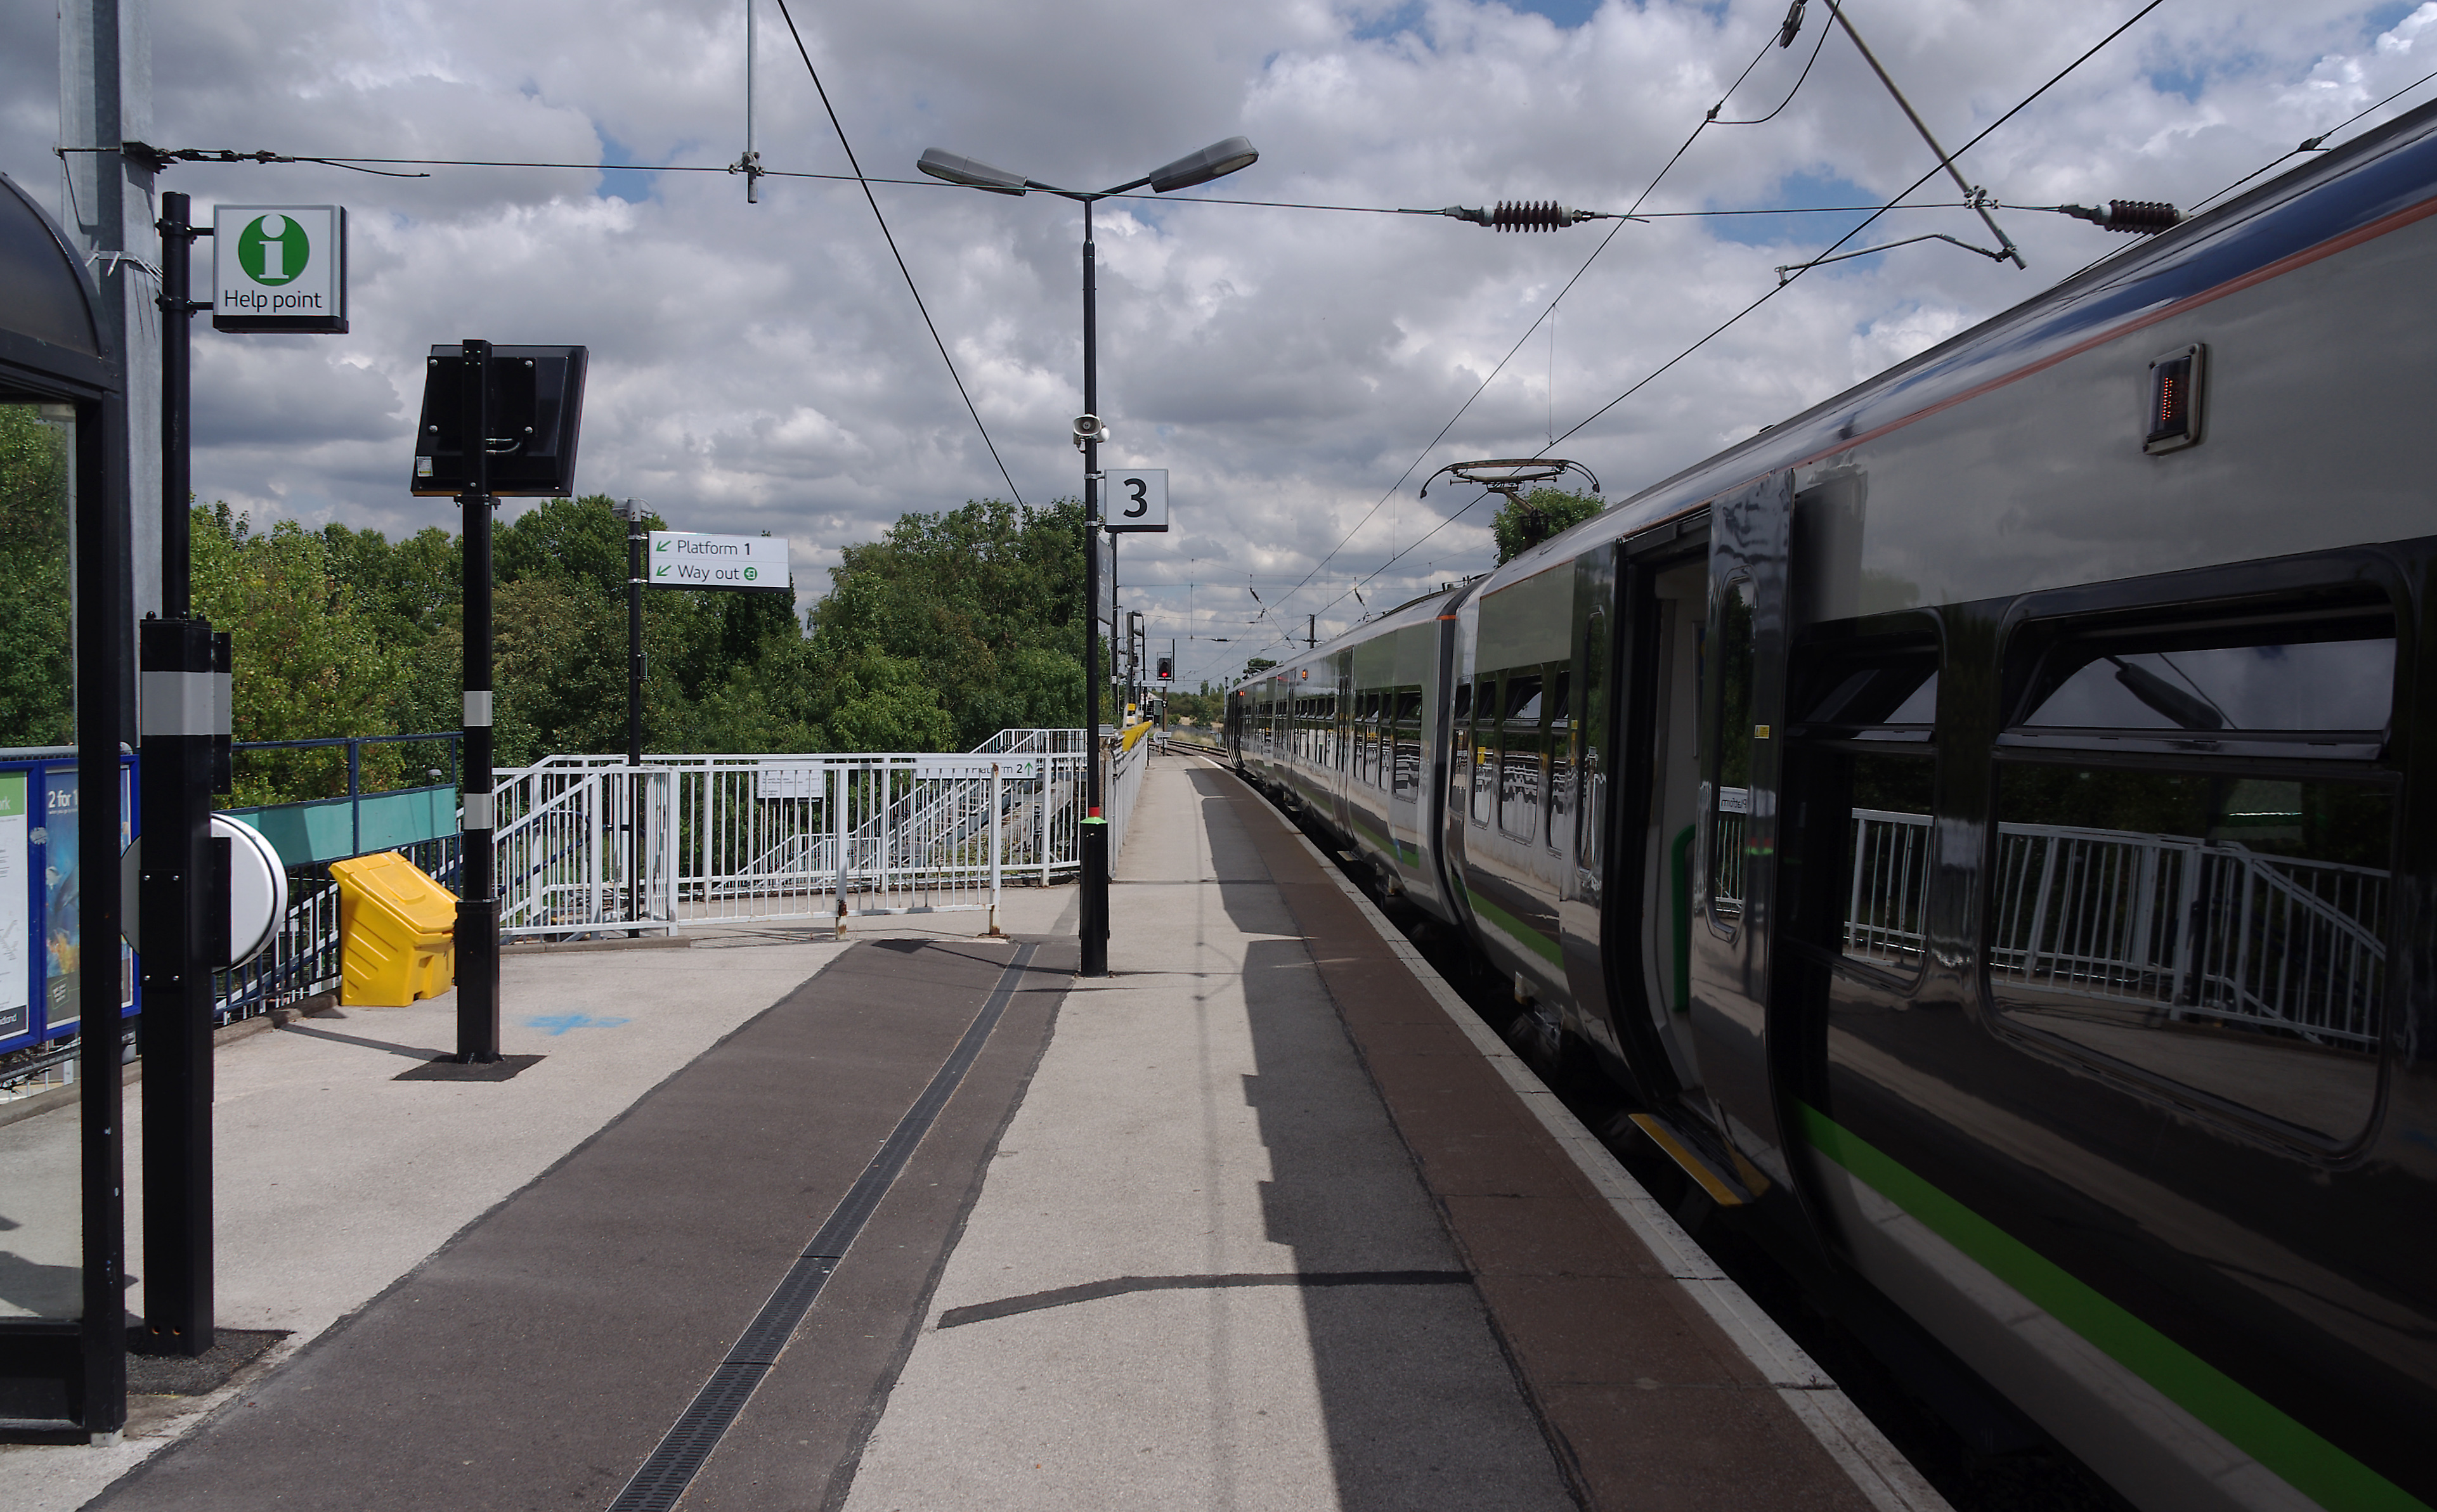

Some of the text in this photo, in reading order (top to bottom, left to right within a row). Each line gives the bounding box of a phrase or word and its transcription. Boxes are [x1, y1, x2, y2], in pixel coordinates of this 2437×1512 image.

[224, 290, 322, 313] Help point
[1123, 477, 1147, 518] 3
[677, 540, 750, 555] Platform 1
[677, 564, 740, 583] Way out
[1017, 763, 1022, 773] 2
[48, 791, 56, 808] 2
[57, 789, 72, 807] for
